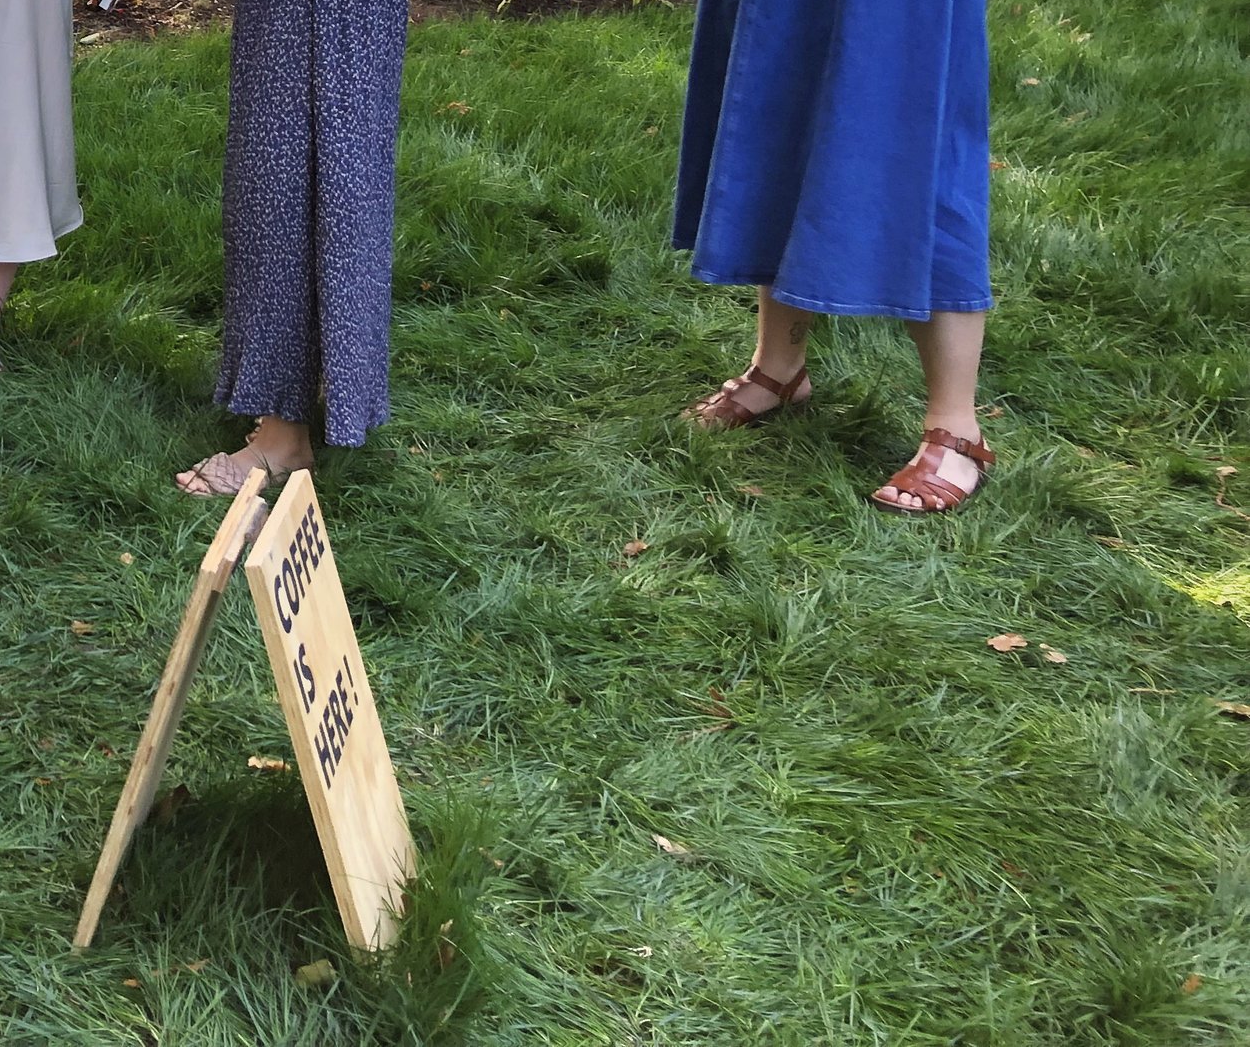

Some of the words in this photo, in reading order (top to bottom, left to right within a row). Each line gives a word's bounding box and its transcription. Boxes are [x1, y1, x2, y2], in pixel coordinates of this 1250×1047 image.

[274, 503, 325, 634] COFFEE
[293, 643, 316, 714] IS
[314, 654, 359, 789] HERE!
